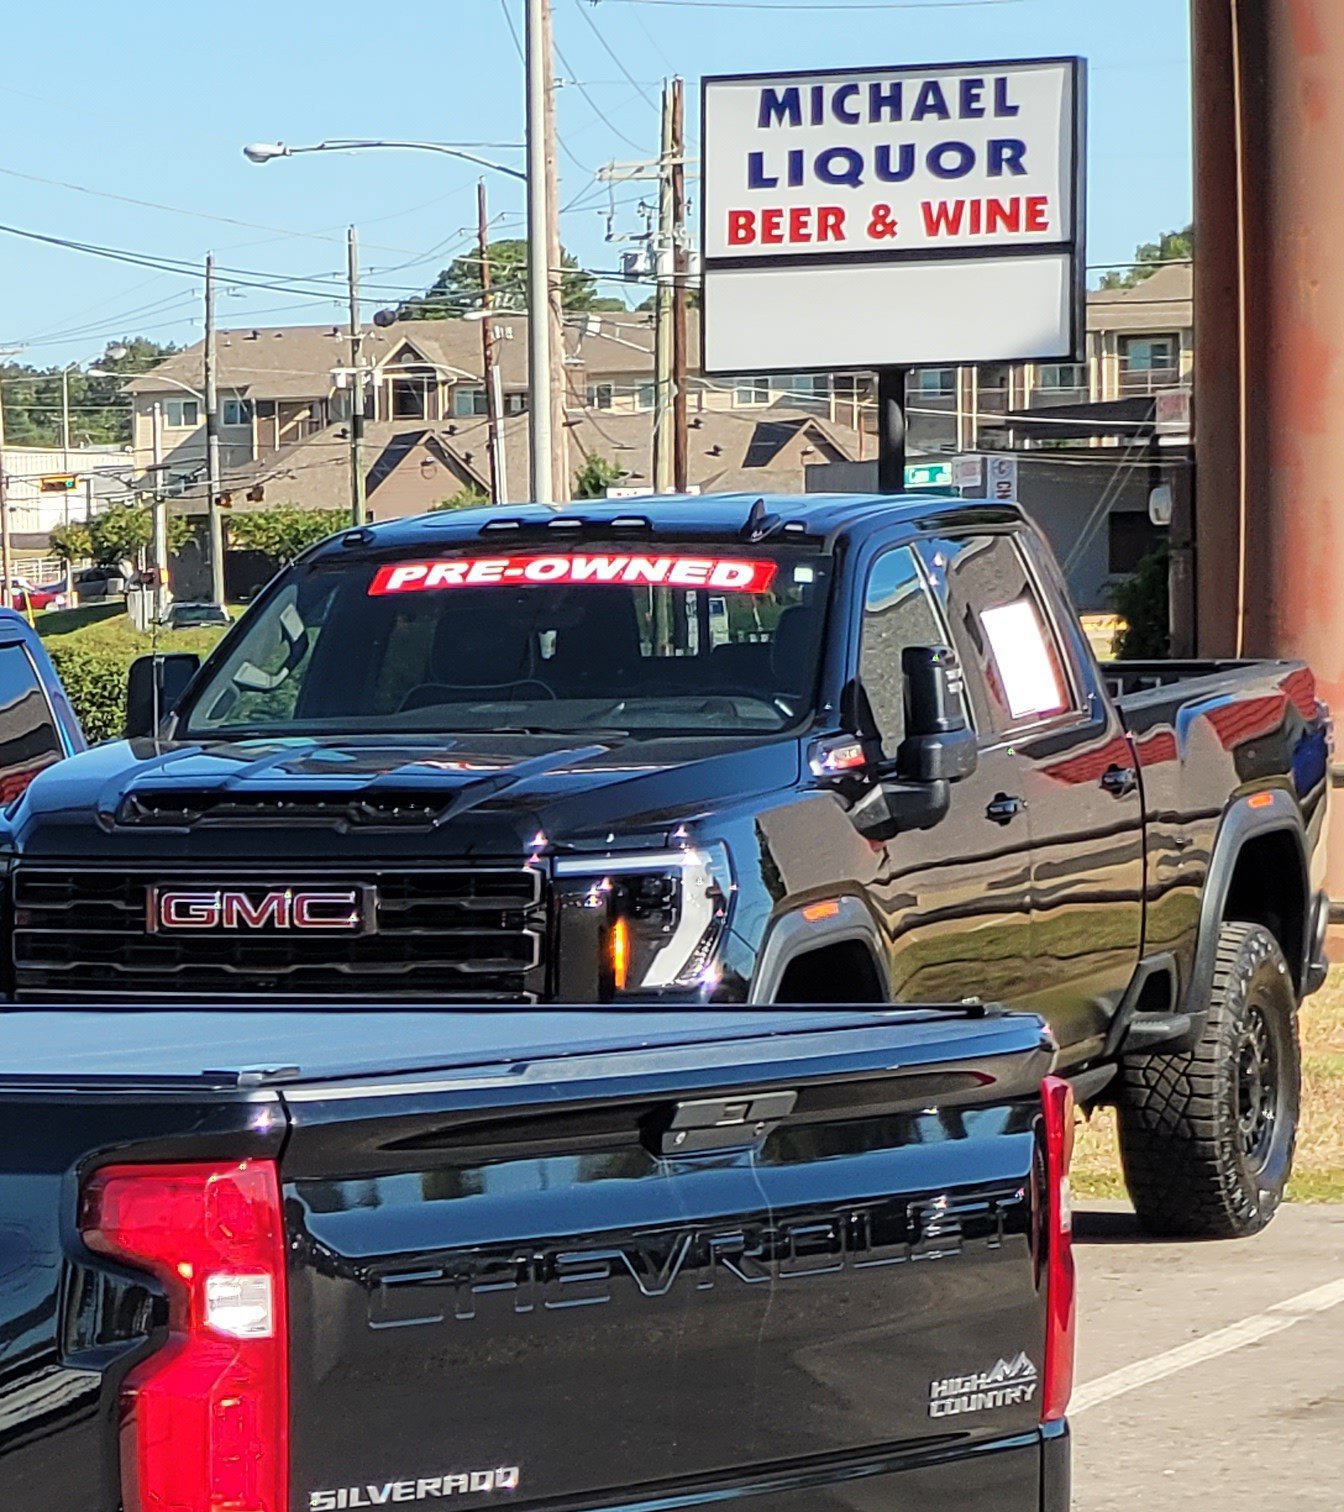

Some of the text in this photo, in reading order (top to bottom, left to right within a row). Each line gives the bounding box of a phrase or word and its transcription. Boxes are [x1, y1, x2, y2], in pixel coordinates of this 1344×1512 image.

[758, 77, 1020, 128] MICHAEL
[748, 138, 1028, 189] LIQUOR
[728, 196, 1049, 245] BEER & WINE
[385, 557, 754, 591] PRE-OWNED
[162, 891, 358, 928] GMC
[368, 1194, 1025, 1329] CHEVROLET
[929, 1383, 1036, 1417] COUNTRY
[931, 1373, 988, 1399] HIGH
[310, 1466, 519, 1512] SILVERADO
